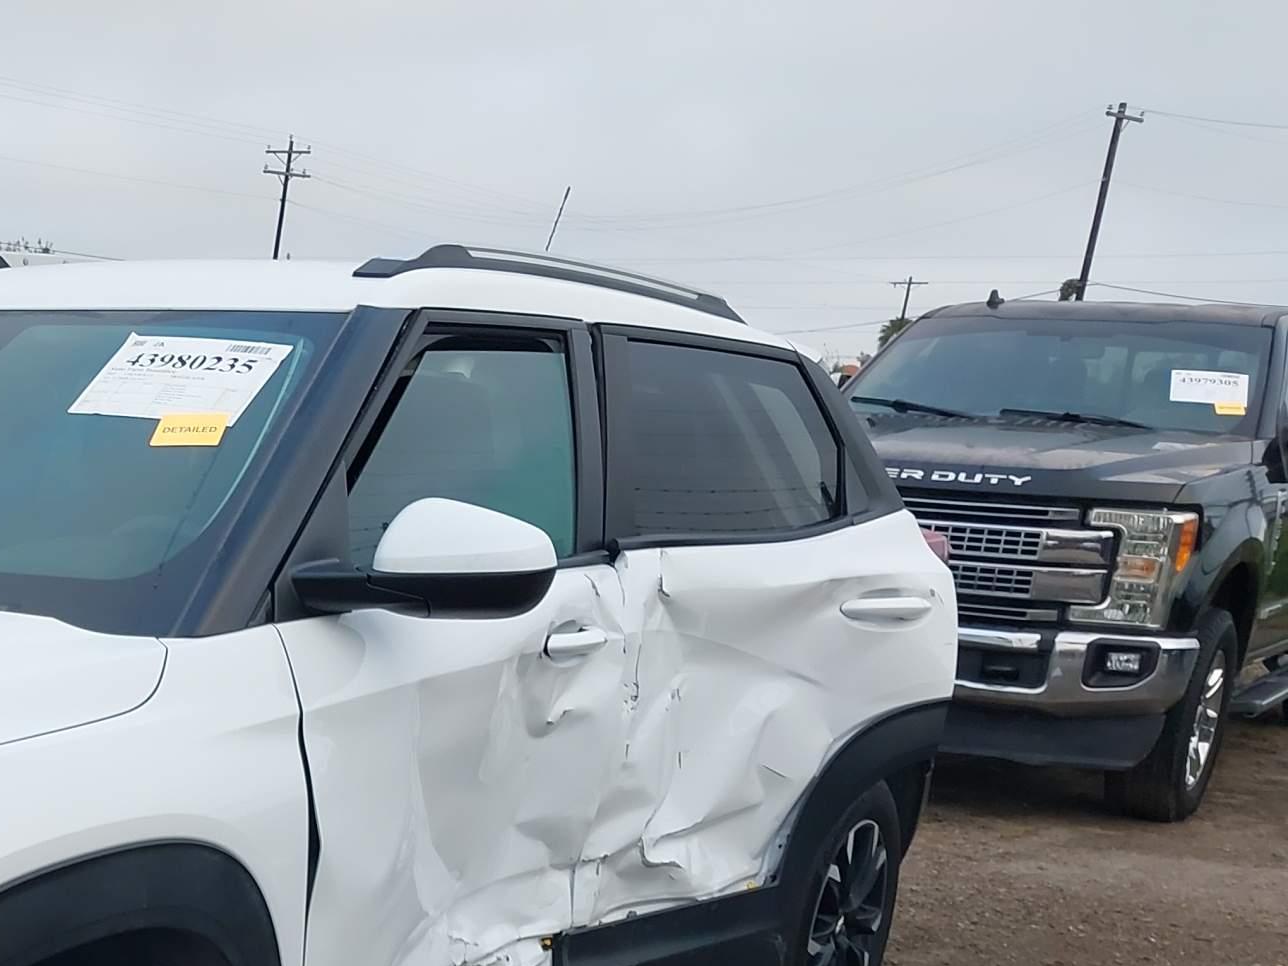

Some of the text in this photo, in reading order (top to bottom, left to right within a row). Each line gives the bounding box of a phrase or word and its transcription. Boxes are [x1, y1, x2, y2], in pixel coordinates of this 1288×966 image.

[125, 352, 258, 375] 43980235
[162, 425, 218, 434] DETAILED
[931, 470, 1032, 486] DUTY
